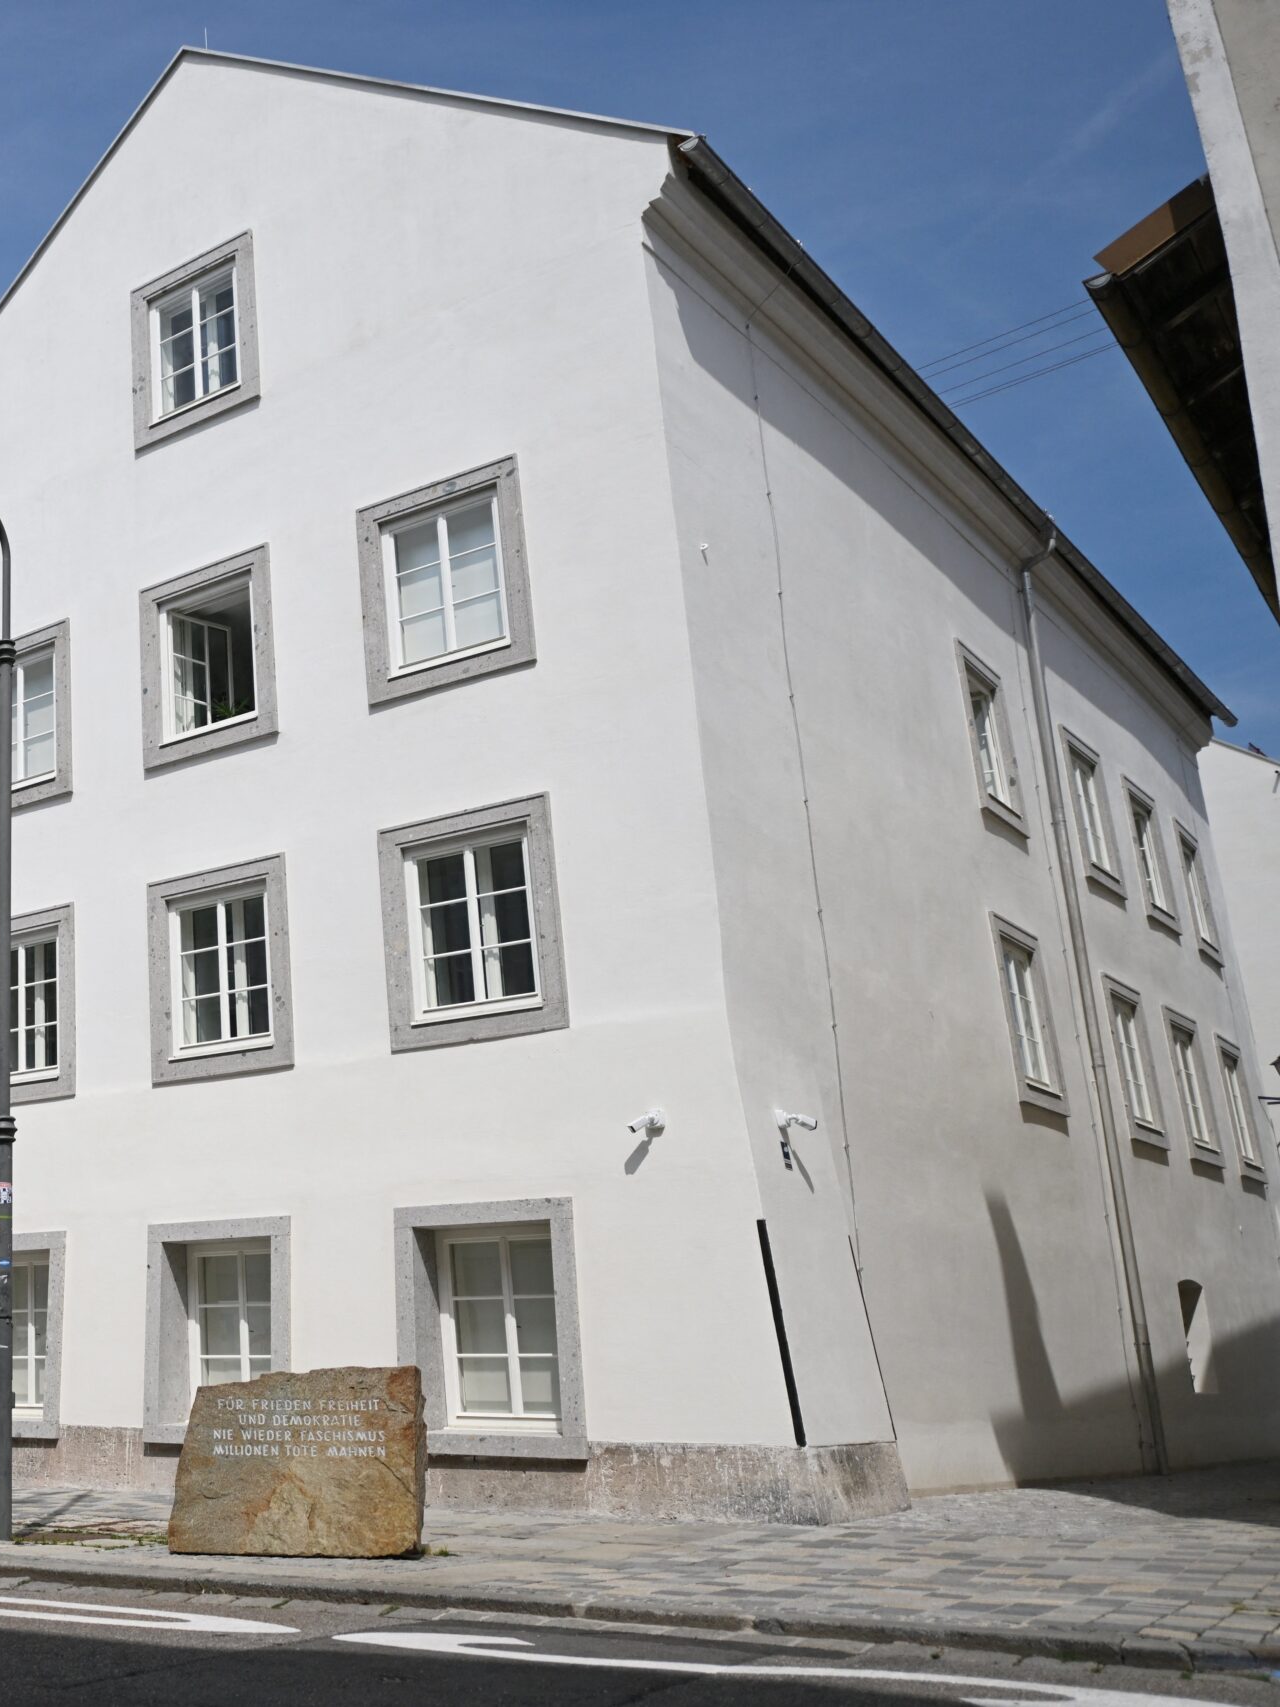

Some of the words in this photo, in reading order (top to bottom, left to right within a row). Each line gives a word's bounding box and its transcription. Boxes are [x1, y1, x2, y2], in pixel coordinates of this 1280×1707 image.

[217, 1396, 244, 1410] FÜR
[252, 1399, 312, 1411] FRIEDEN
[320, 1399, 380, 1411] FREIHEIT
[238, 1414, 266, 1425] UND
[273, 1414, 361, 1427] DEMOKRATIE
[213, 1429, 233, 1441] NIE
[241, 1429, 292, 1441] WIEDER
[300, 1430, 386, 1442] FASCHISMUS
[213, 1444, 279, 1457] MILLIONEN
[285, 1444, 318, 1457] TOTE
[327, 1445, 387, 1457] MAHNEN
